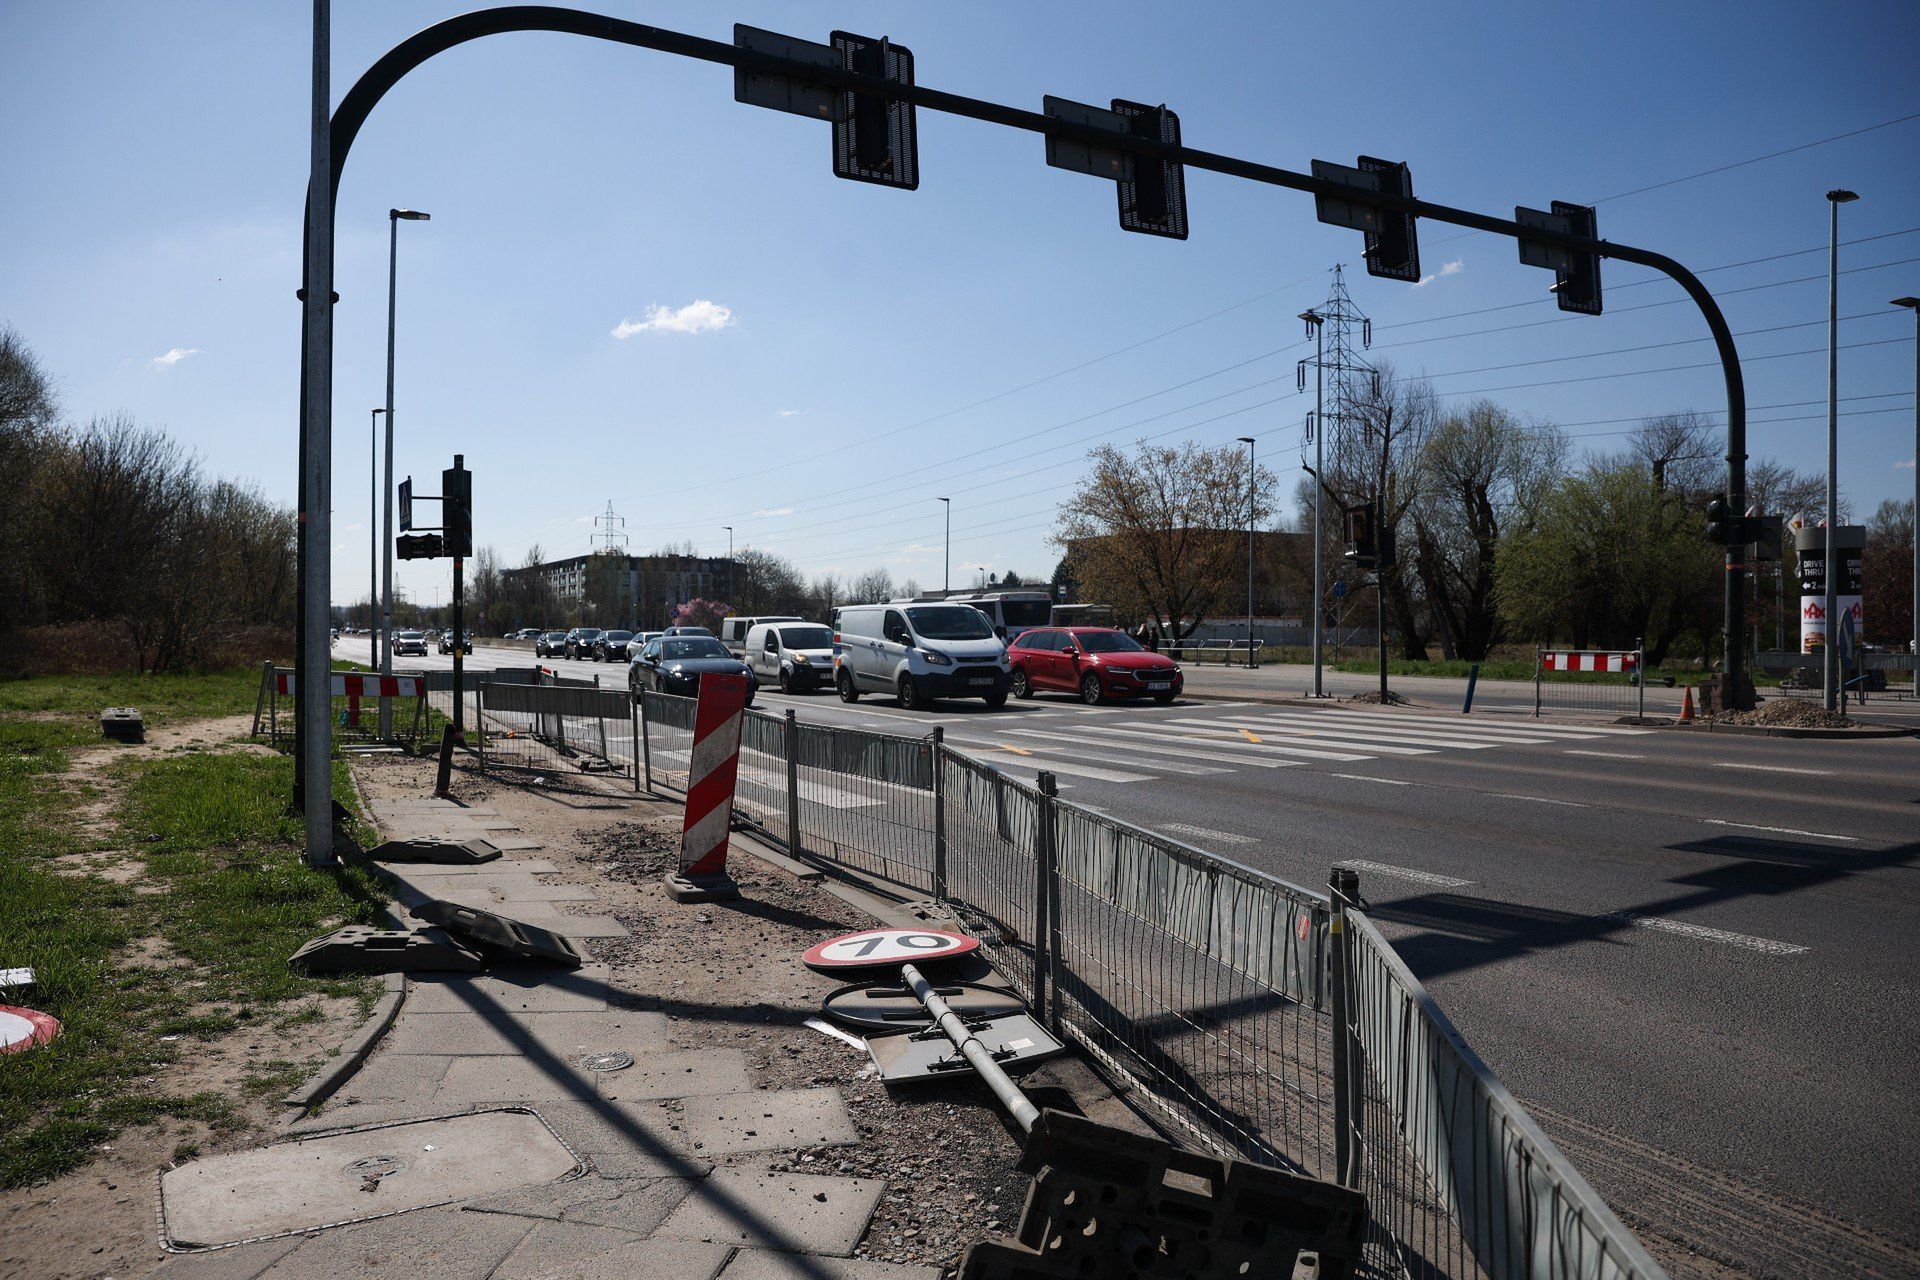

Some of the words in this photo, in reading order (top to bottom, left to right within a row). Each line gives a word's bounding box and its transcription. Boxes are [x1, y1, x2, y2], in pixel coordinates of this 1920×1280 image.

[1803, 560, 1824, 568] DRIVE
[1804, 568, 1823, 576] THRU
[1811, 582, 1817, 590] 2
[1850, 581, 1855, 589] 2
[1804, 602, 1825, 618] MAX
[839, 934, 951, 957] 70
